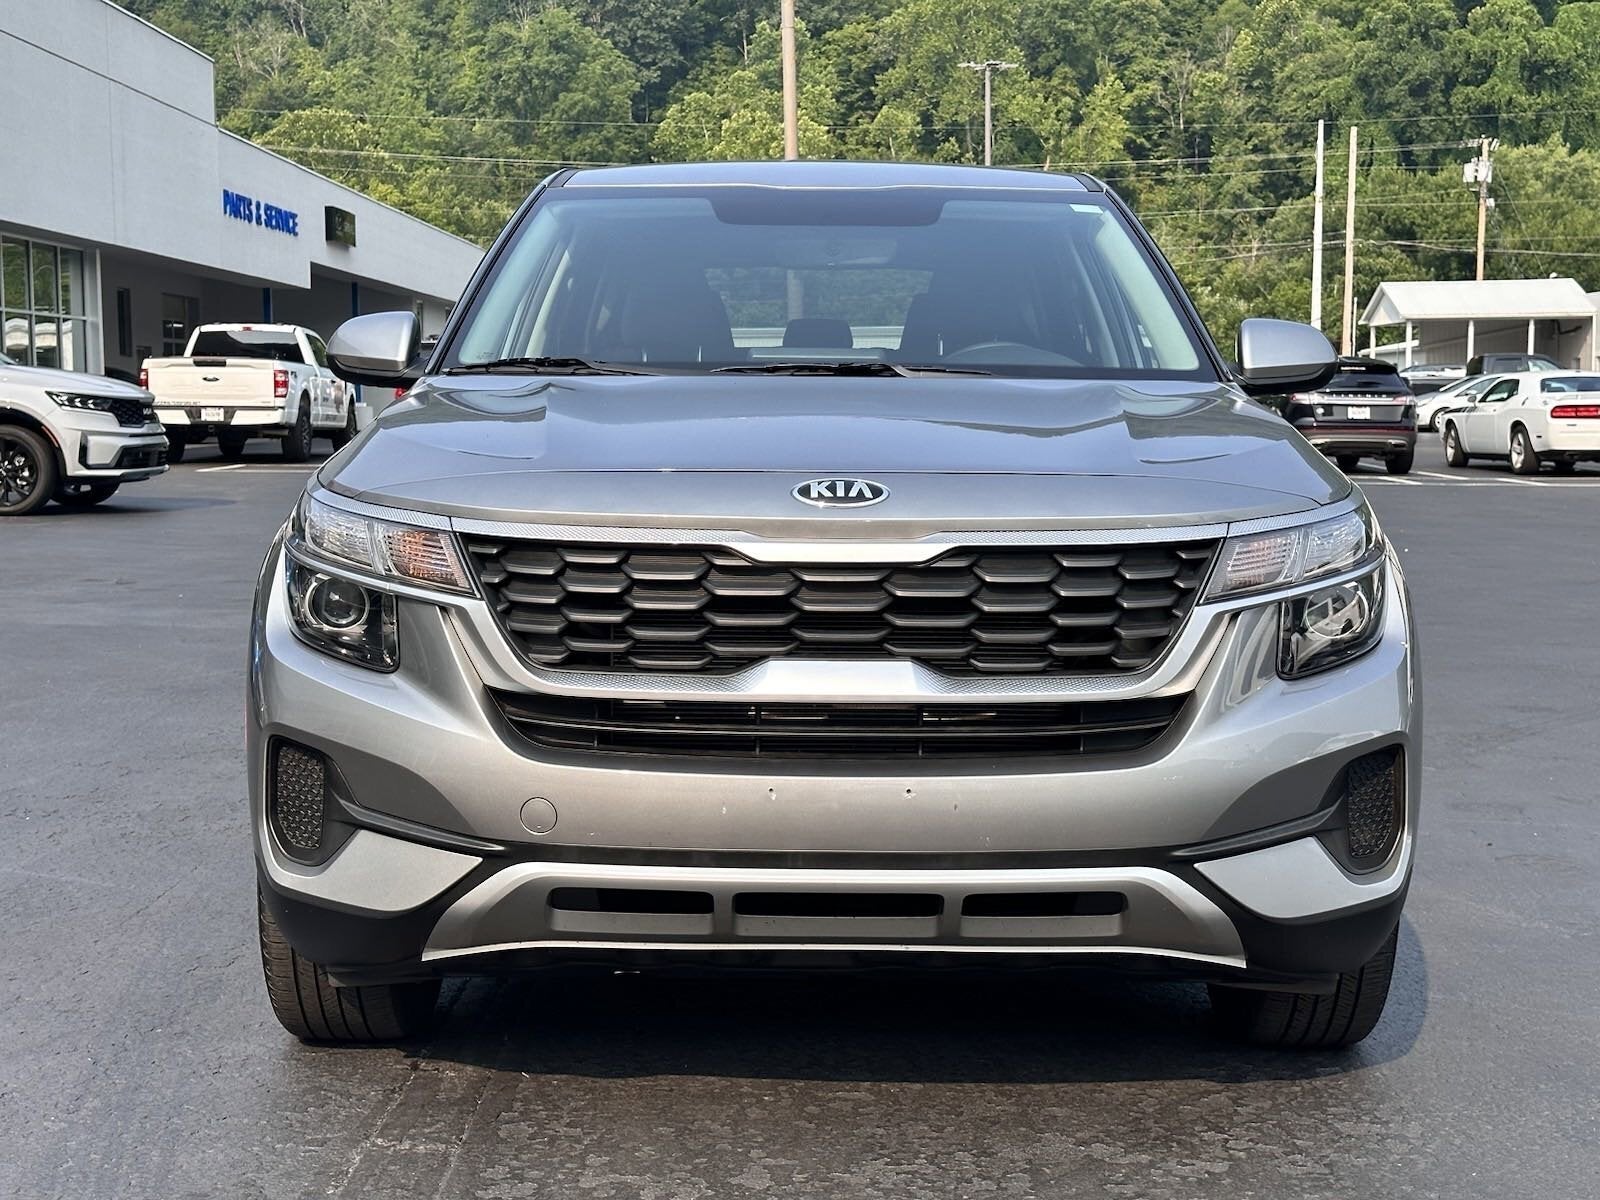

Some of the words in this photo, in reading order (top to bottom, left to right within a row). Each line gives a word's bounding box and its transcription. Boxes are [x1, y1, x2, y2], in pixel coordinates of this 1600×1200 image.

[223, 189, 253, 224] PARTS
[255, 200, 262, 226] &
[264, 203, 298, 237] SERVICE
[809, 481, 873, 499] KIA
